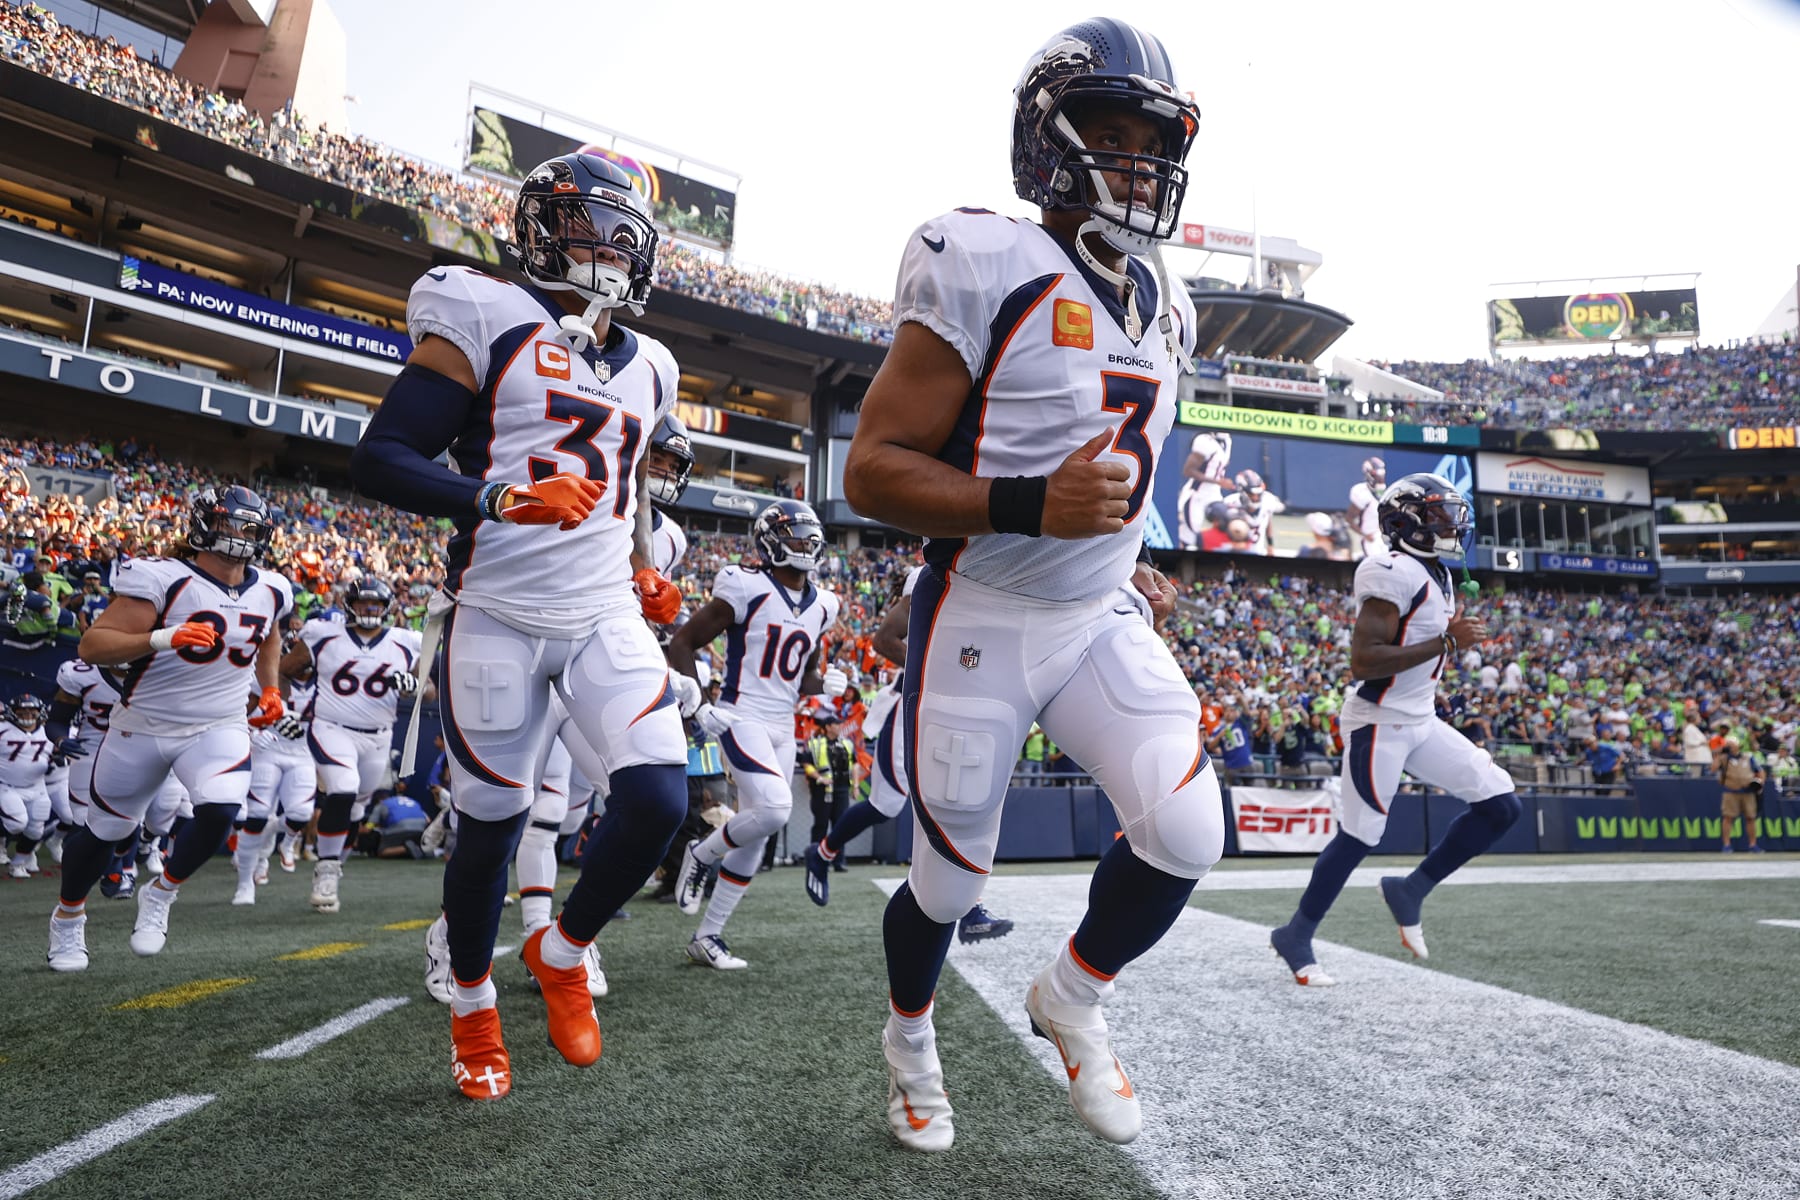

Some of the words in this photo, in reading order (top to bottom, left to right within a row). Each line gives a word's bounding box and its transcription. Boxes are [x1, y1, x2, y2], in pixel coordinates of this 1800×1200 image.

[158, 282, 185, 301] PA:
[190, 291, 233, 314] NOW
[238, 306, 320, 338] ENTERING
[323, 327, 352, 347] THE
[356, 336, 402, 360] FIELD.
[1057, 302, 1091, 334] C
[1570, 305, 1620, 324] DEN
[539, 344, 570, 371] C
[1108, 354, 1154, 370] BRONCOS
[41, 349, 134, 395] TO
[200, 386, 371, 440] LUM
[577, 384, 622, 403] BRONCOS
[1232, 376, 1271, 388] TOYOTA
[1275, 381, 1293, 390] FAN
[1188, 406, 1293, 431] COUNTDOWN
[1300, 418, 1318, 431] TO
[1323, 421, 1386, 437] KICKOFF
[1101, 371, 1161, 524] 3
[1737, 428, 1796, 449] DEN
[528, 389, 642, 520] 31
[36, 475, 95, 495] 117
[1509, 471, 1563, 482] AMERICAN
[1567, 475, 1603, 487] FAMILY
[175, 611, 268, 668] 83
[759, 622, 811, 682] 10
[332, 660, 392, 698] 66
[7, 740, 47, 762] 77
[1238, 804, 1331, 834] ESPN
